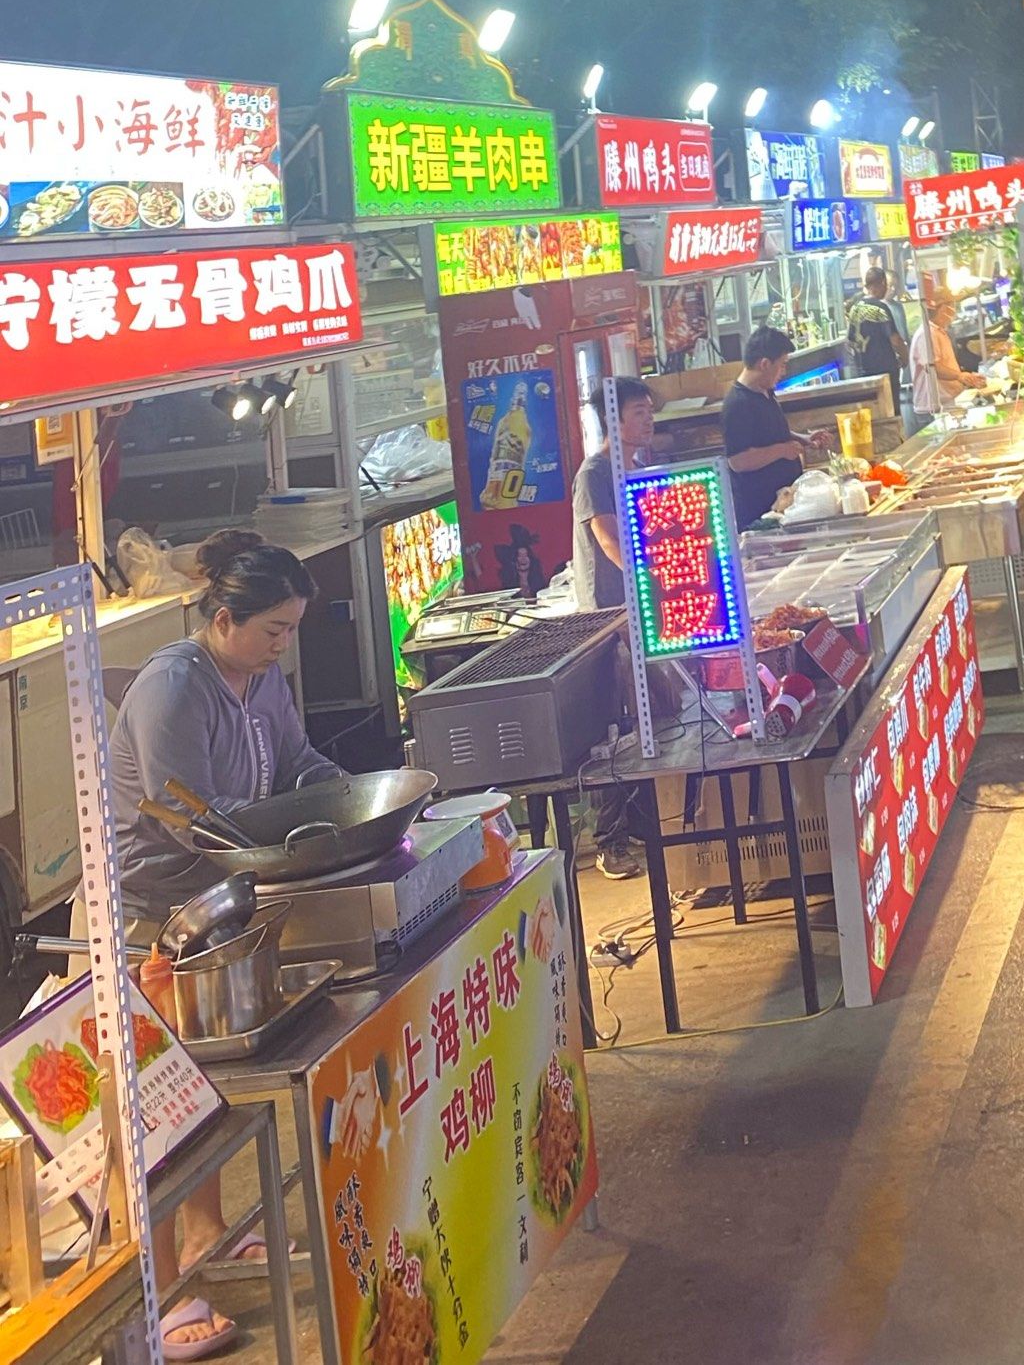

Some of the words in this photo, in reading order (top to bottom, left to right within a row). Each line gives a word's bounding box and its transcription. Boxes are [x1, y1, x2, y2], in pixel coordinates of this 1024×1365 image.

[0, 91, 205, 157] 汁小海鲜
[367, 118, 549, 192] 新疆羊肉串
[467, 352, 539, 379] 好久不见
[400, 930, 521, 1117] 上海特味
[440, 1058, 496, 1164] 鸡柳
